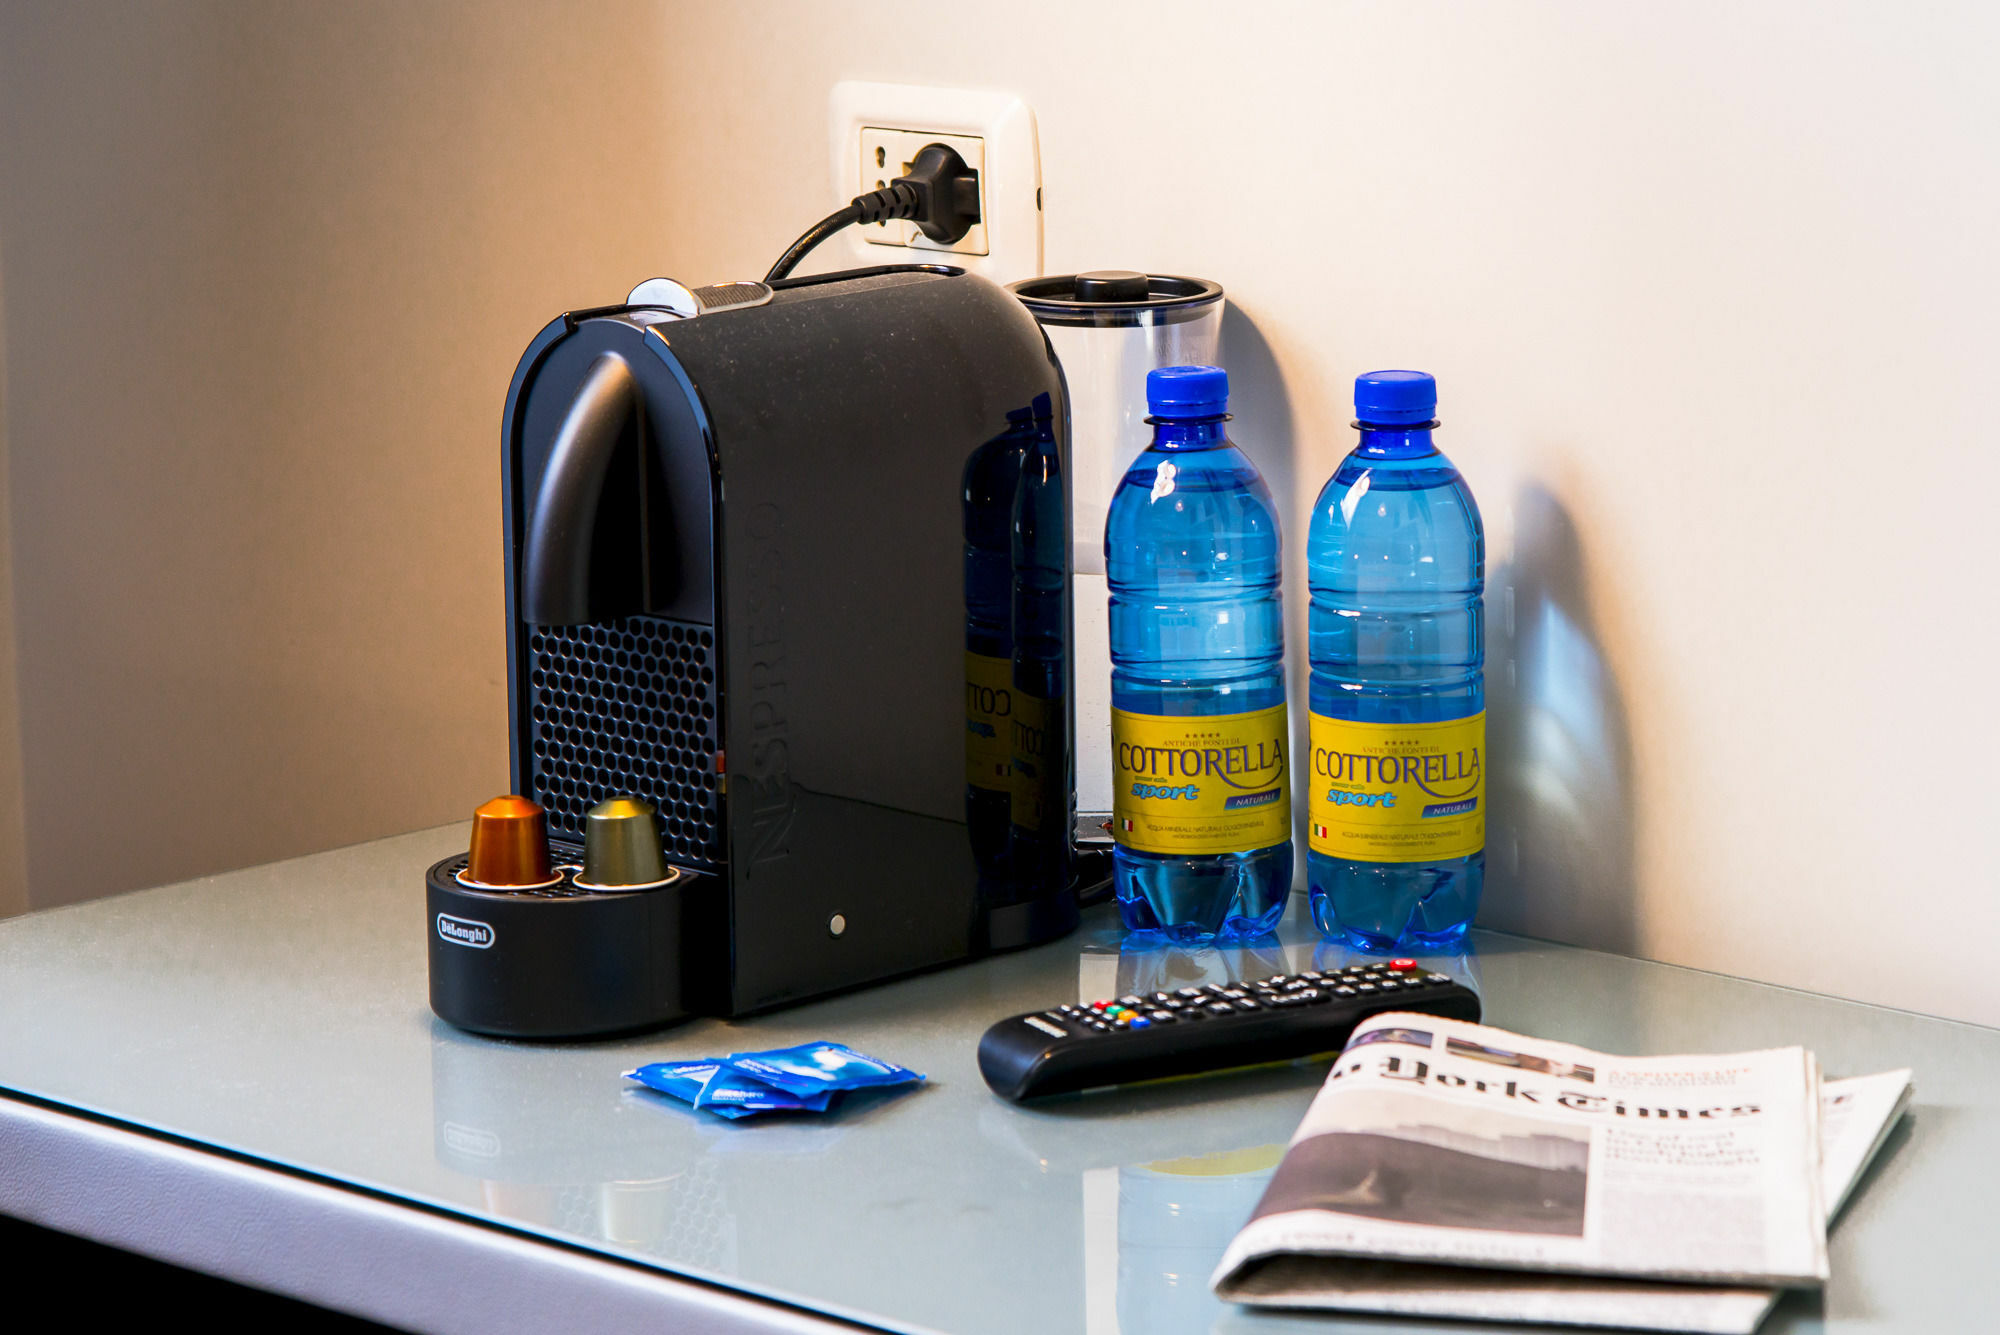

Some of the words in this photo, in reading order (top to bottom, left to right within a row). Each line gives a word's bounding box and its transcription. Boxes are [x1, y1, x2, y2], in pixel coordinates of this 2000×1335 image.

[1119, 738, 1283, 789] COTTORELLA
[1316, 747, 1481, 798] COTTORELLA
[1131, 783, 1200, 800] sport
[1236, 793, 1276, 806] NATURALE
[1327, 789, 1397, 808] sport
[1433, 801, 1473, 815] NATURALE
[1379, 1056, 1540, 1103] York
[1557, 1090, 1761, 1120] Times
